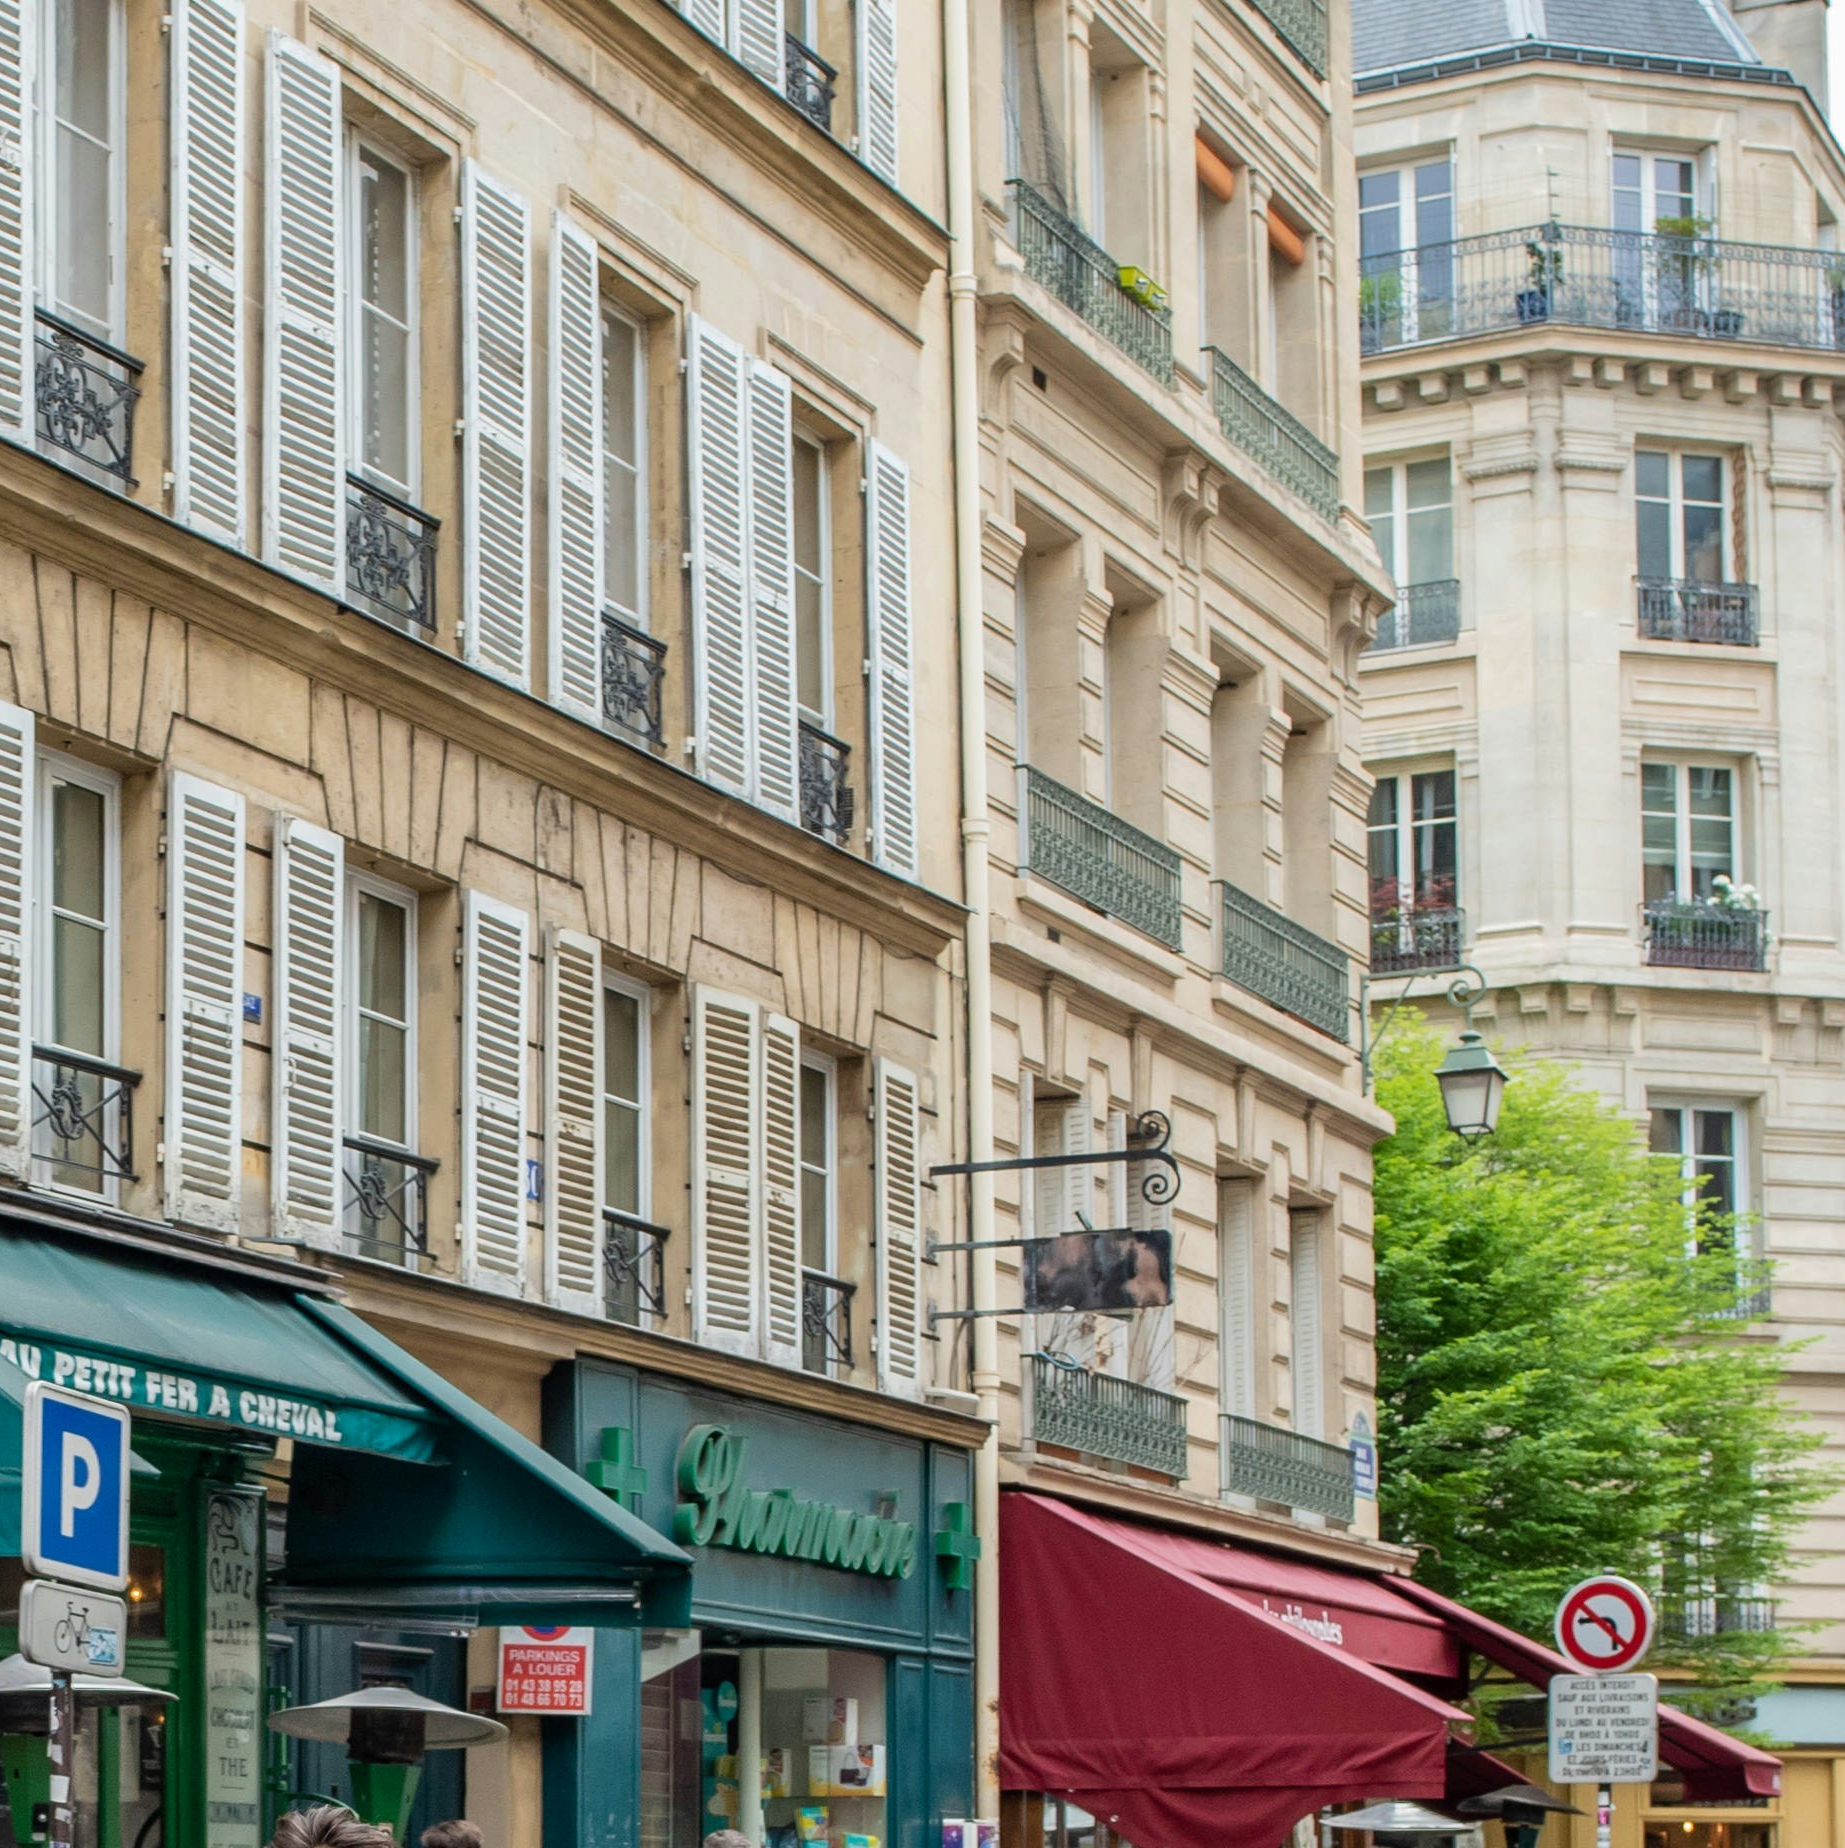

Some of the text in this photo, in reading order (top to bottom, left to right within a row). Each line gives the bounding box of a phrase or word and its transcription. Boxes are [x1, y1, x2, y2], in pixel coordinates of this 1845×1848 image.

[53, 1350, 136, 1399] PETIT
[145, 1371, 199, 1413] FER
[207, 1384, 231, 1418] A
[238, 1390, 343, 1442] CHEVAL
[59, 1433, 101, 1538] P
[509, 1649, 581, 1663] PARKINGS
[512, 1663, 576, 1676] A LOUER
[505, 1679, 518, 1691] 01
[1599, 1680, 1636, 1690] INTERDIT
[1557, 1692, 1649, 1703] SAUF AUX LIVRAISONS
[1574, 1706, 1584, 1715] ET
[1569, 1718, 1592, 1727] LUNDI
[1610, 1718, 1649, 1727] VENDREDI
